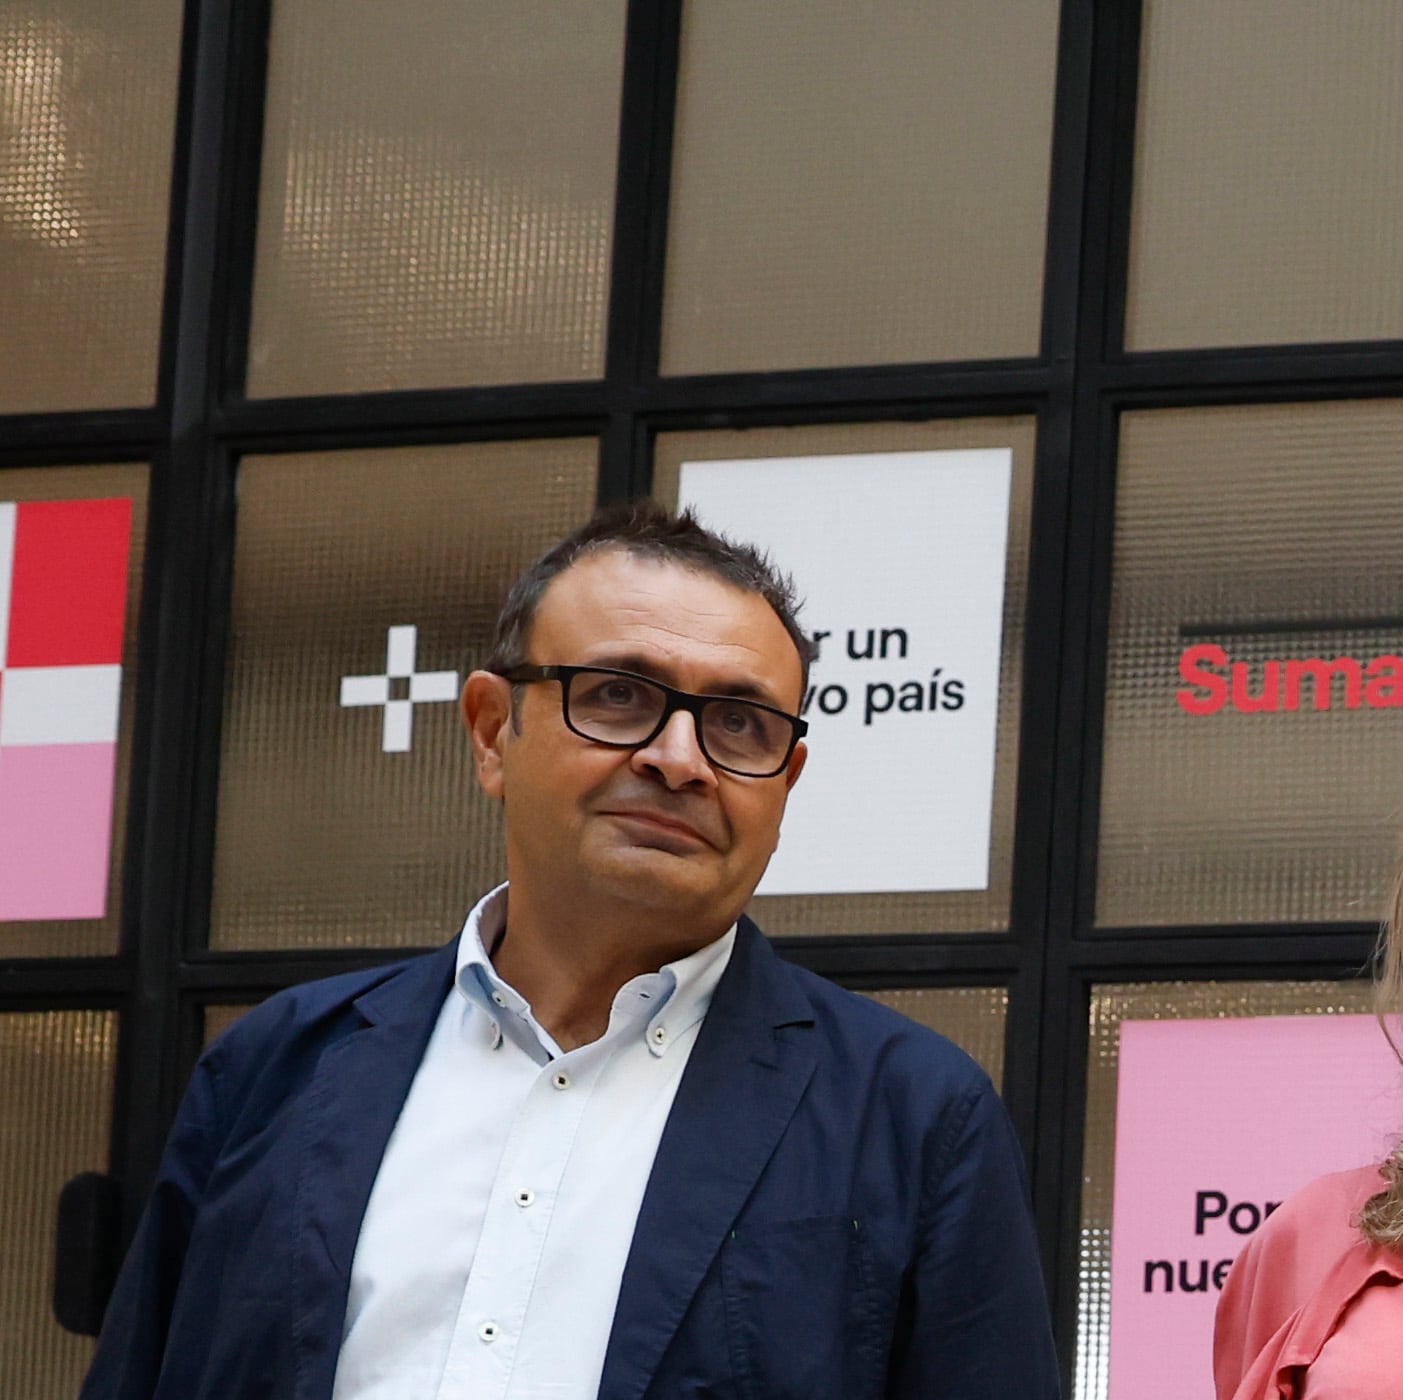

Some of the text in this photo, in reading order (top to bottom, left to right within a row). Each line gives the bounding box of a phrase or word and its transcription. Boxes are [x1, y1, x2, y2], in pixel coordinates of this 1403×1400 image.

[846, 627, 908, 660] un
[864, 668, 966, 726] país
[1143, 1259, 1234, 1293] nue
